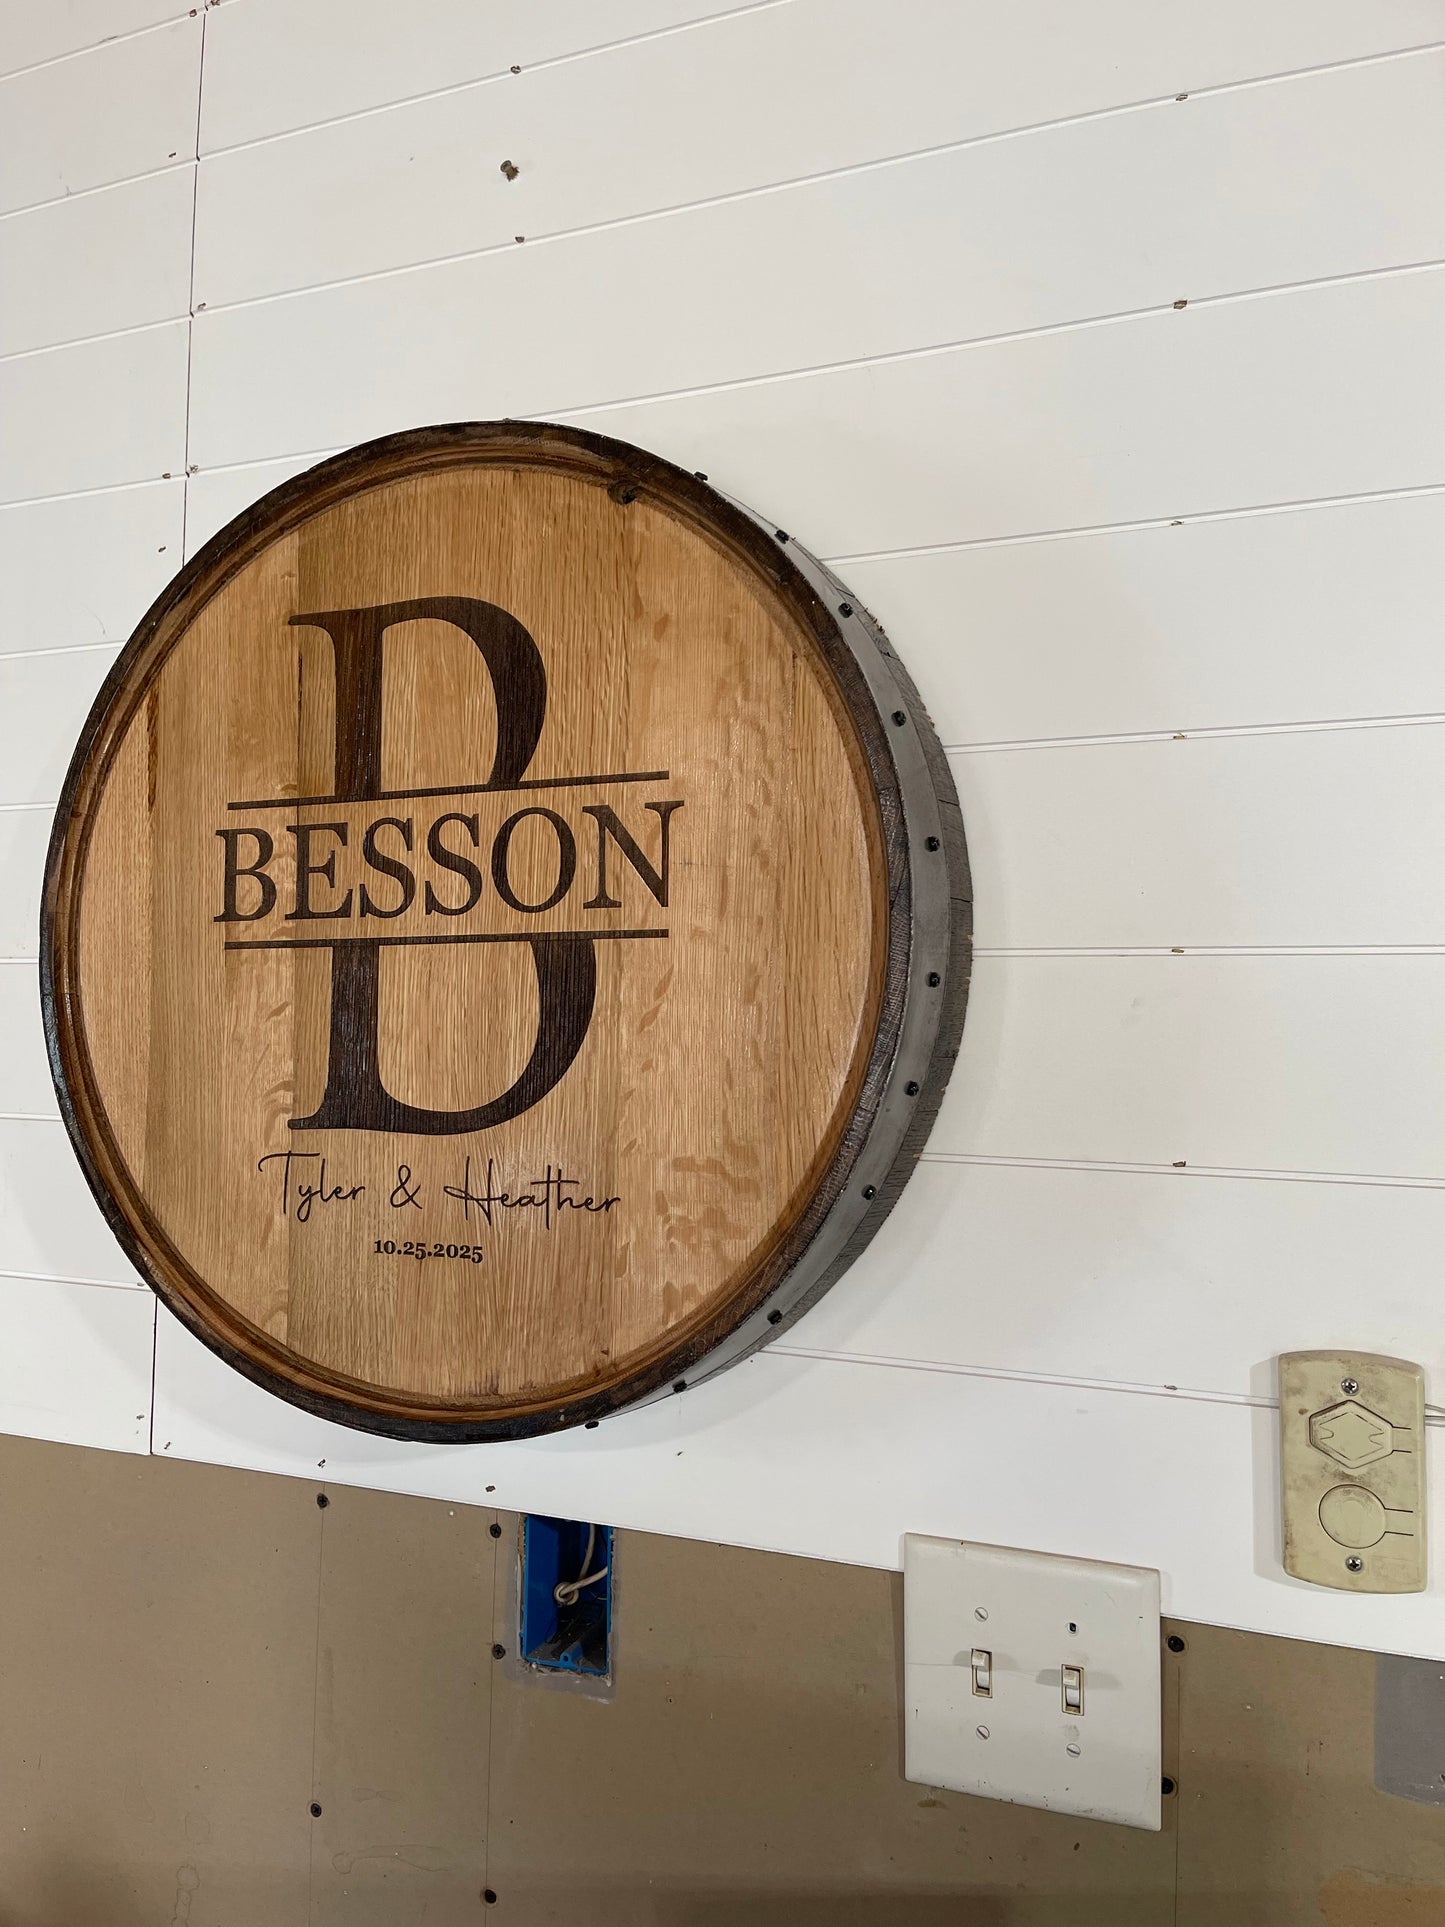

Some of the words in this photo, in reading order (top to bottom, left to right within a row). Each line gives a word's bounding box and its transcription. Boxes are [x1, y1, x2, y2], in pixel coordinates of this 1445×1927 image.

[213, 800, 685, 922] BESSON
[288, 596, 597, 1136] B
[258, 1150, 366, 1223] Tyler
[389, 1164, 423, 1210] &
[443, 1156, 622, 1231] Heather
[373, 1239, 484, 1264] 10.25.2025
